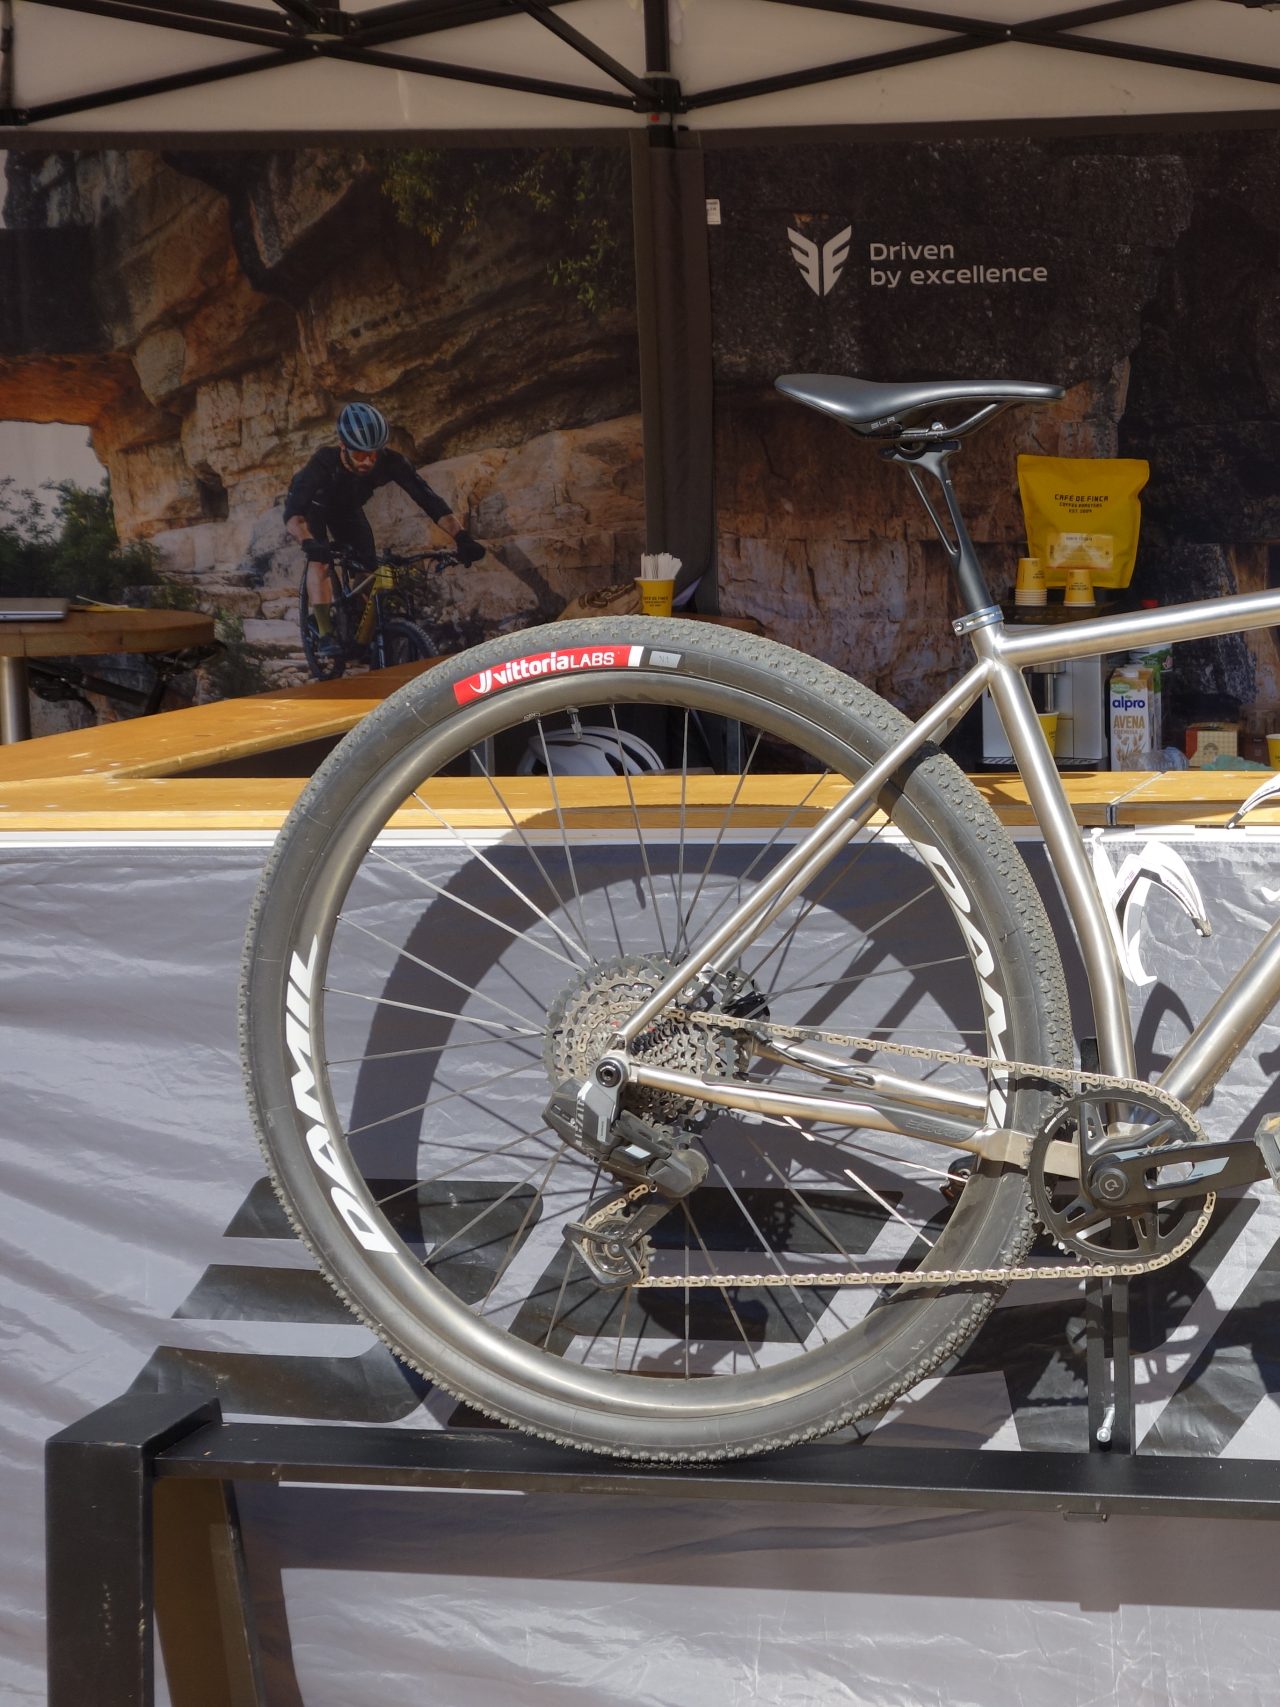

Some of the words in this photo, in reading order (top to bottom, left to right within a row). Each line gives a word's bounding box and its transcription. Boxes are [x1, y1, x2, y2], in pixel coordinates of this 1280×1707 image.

[869, 242, 955, 261] Driven
[870, 267, 901, 288] by
[910, 265, 1048, 285] excellence
[1112, 695, 1146, 711] alpro
[1113, 714, 1145, 729] AVENA
[911, 840, 1009, 1128] DAMI
[286, 934, 398, 1254] DAMIL
